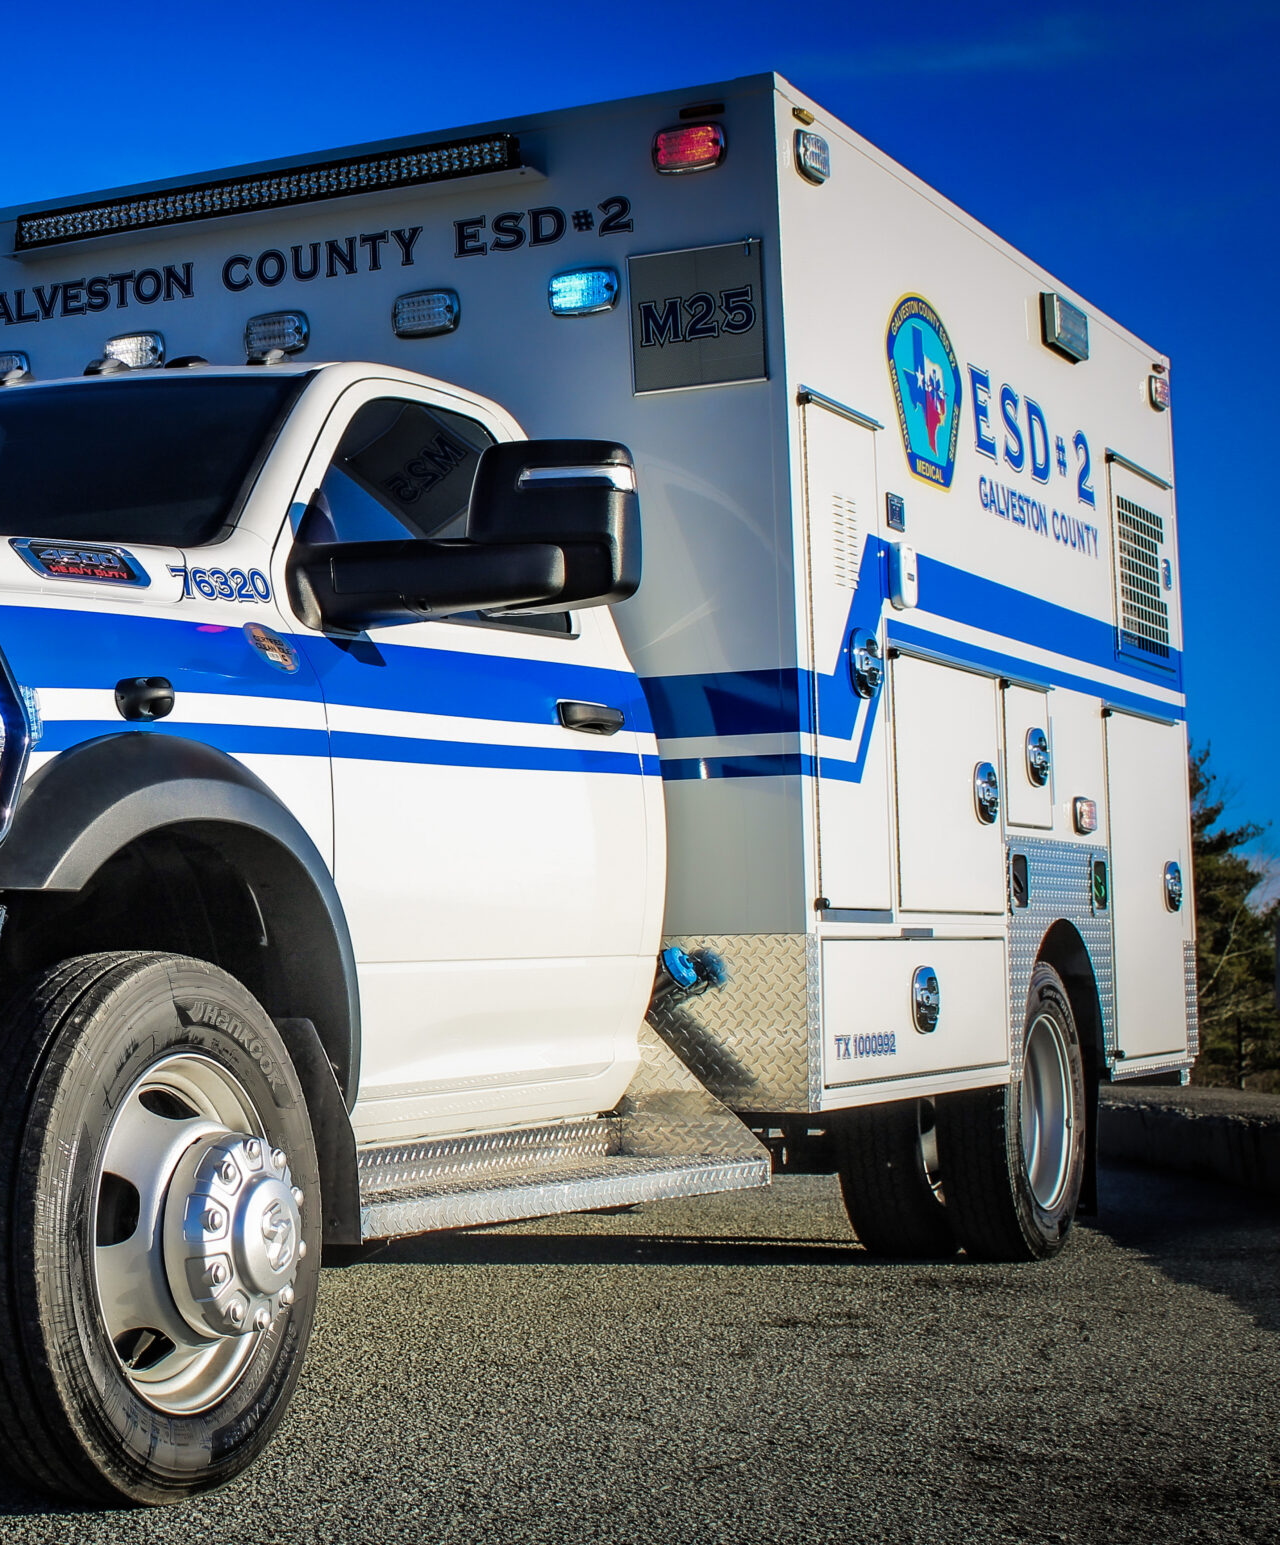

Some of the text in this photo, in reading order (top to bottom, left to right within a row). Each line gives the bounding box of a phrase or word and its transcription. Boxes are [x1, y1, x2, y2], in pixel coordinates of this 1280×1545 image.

[222, 226, 424, 292] COUNTY
[639, 285, 756, 348] M25
[891, 302, 919, 336] GALVESTON
[919, 302, 940, 330] COUNTY
[888, 358, 913, 455] EMERGENCY
[948, 402, 960, 463] SERVICE
[916, 458, 945, 484] MEDICAL
[978, 474, 1098, 560] GALVESTON COUNTY
[38, 549, 121, 569] 4500
[49, 565, 128, 579] HEAVY DUTY
[166, 562, 273, 603] 76320
[834, 1030, 896, 1060] TX 1000992
